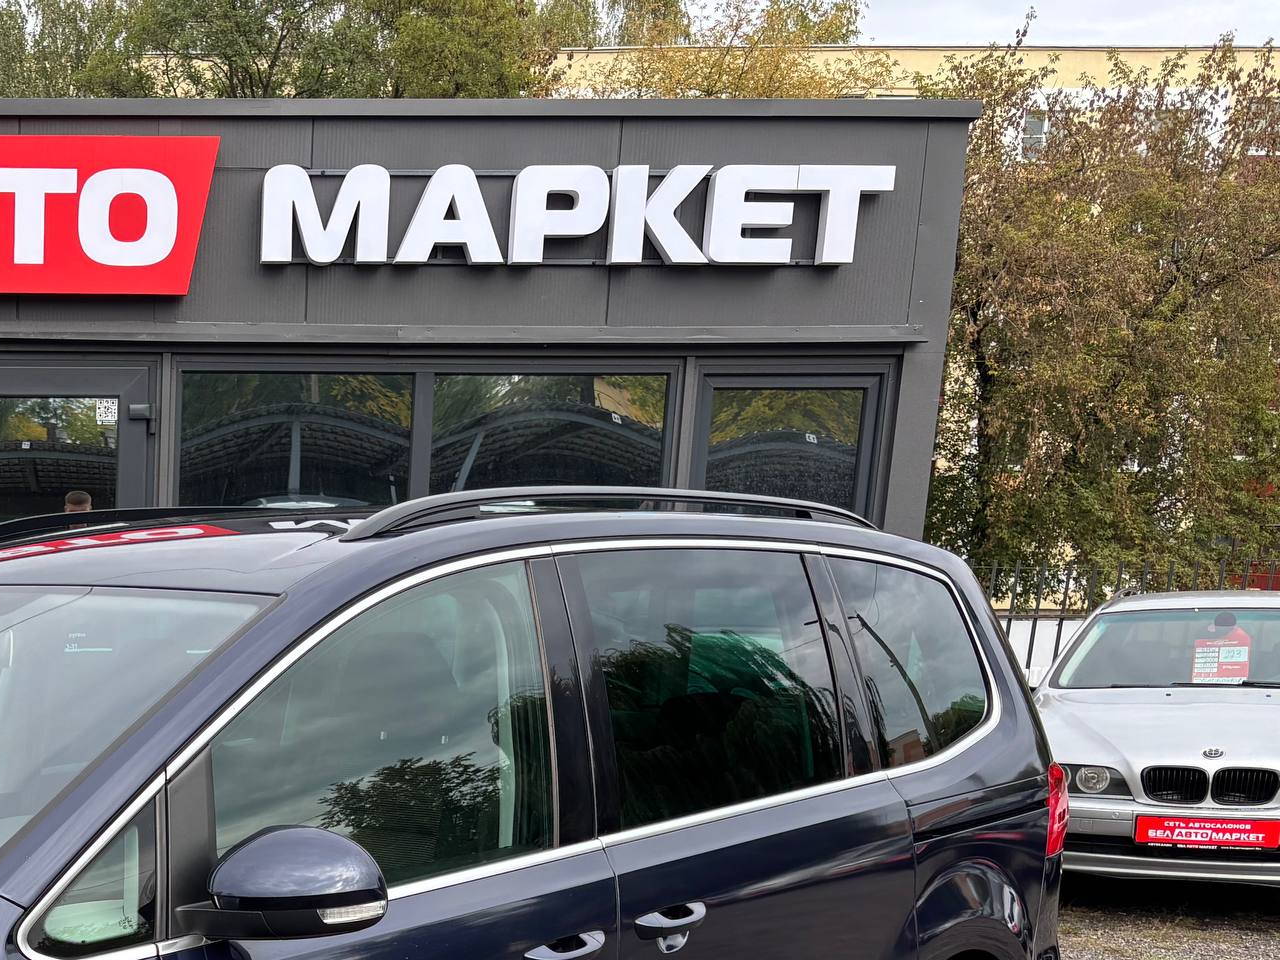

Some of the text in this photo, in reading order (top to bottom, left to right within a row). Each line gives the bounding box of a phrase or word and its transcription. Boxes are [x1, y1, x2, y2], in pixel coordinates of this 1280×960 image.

[260, 163, 896, 267] МАРКЕТ
[1188, 822, 1251, 830] АВТОСАЛОНОВ
[1148, 829, 1265, 842] БЕЛ АВТО МАРКЕТ
